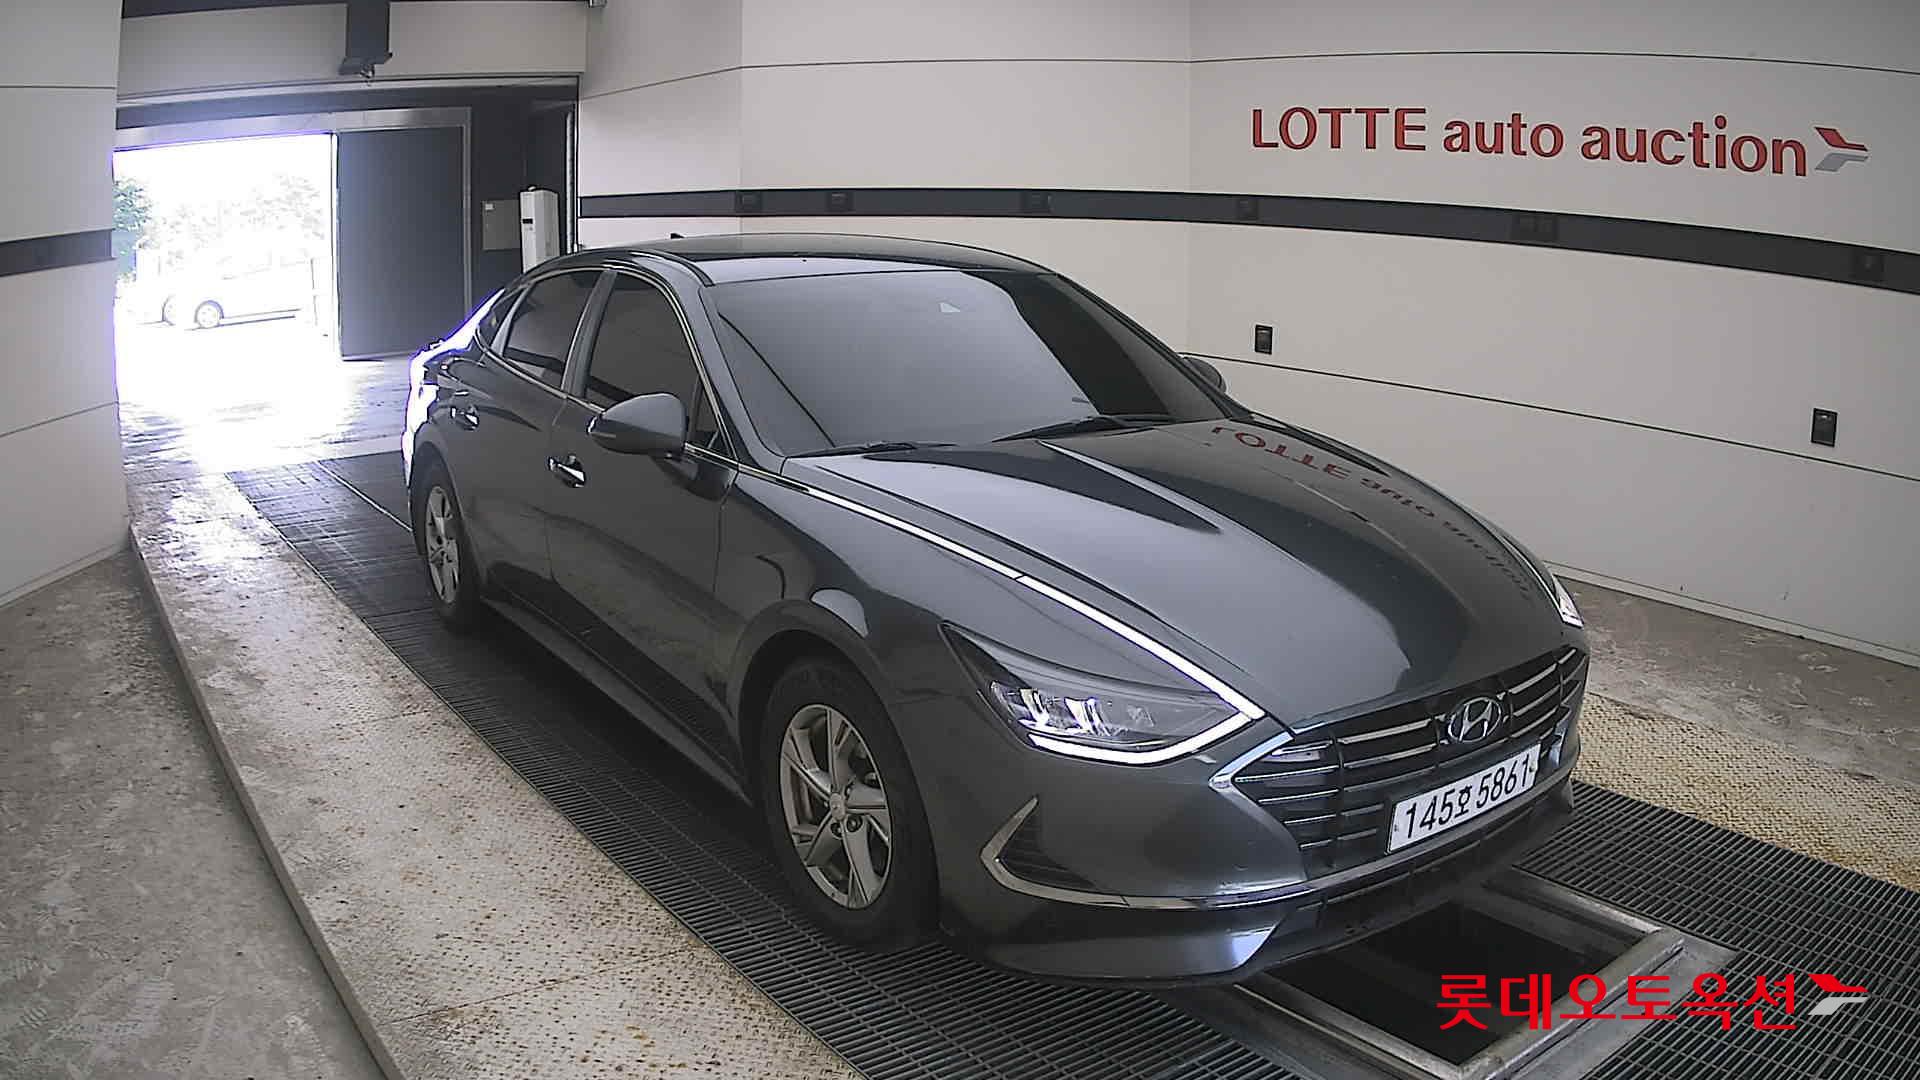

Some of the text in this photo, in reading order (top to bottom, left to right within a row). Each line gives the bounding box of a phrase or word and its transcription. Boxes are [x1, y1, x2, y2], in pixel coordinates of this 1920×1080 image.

[1252, 106, 1808, 177] LOTTE auto auction
[1476, 754, 1531, 809] 5861
